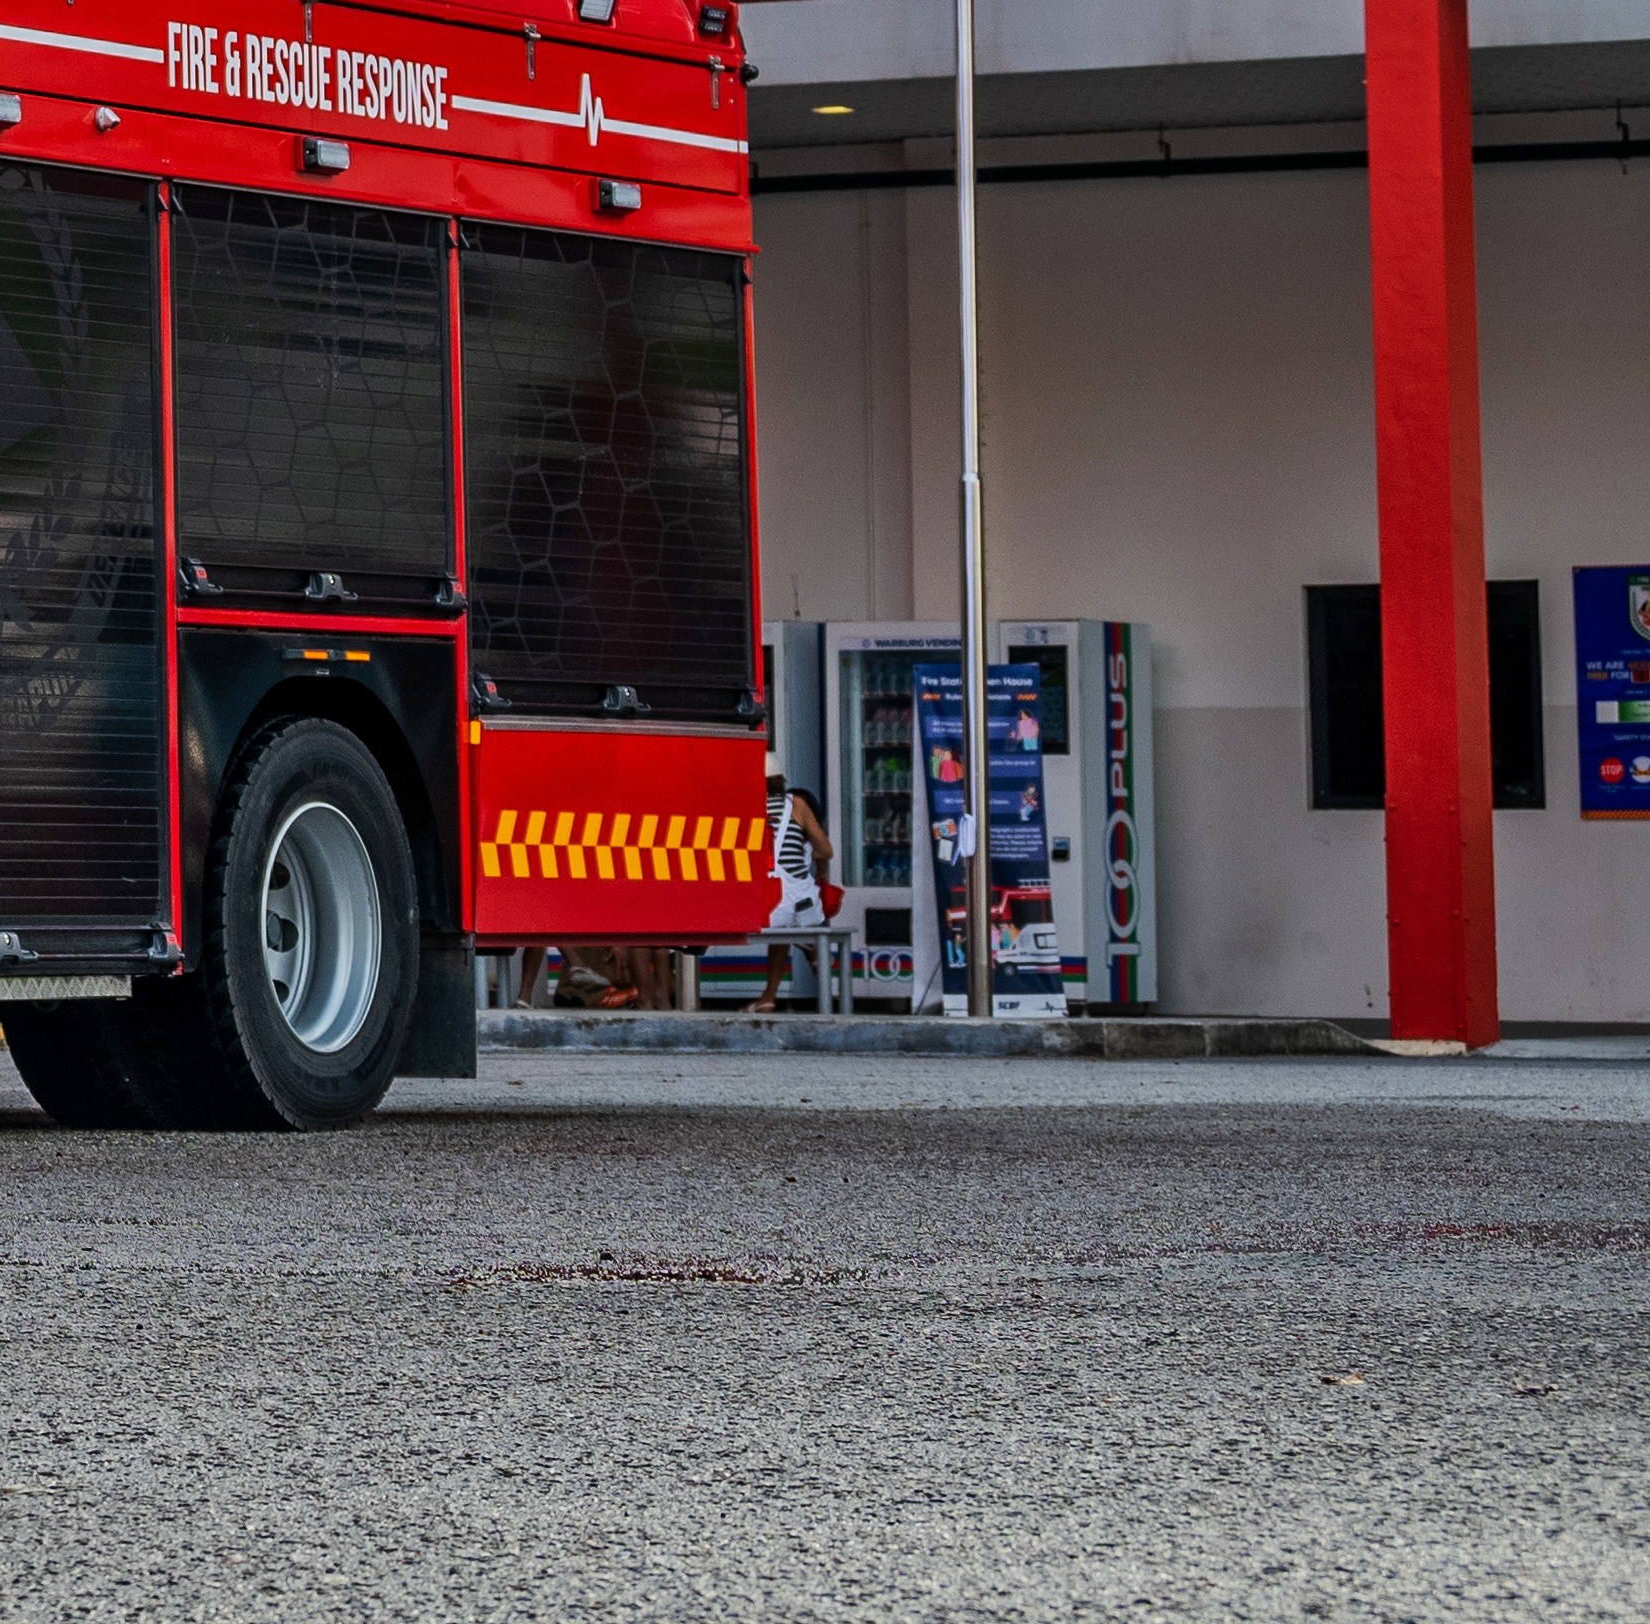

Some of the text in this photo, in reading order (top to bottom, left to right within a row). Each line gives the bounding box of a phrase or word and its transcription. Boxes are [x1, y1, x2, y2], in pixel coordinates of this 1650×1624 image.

[167, 21, 449, 131] FIRE & RESCUE RESPONSE
[924, 639, 963, 648] VENDIN
[1586, 661, 1602, 670] WE
[1605, 660, 1625, 670] ARE
[1610, 671, 1630, 680] FOR
[1003, 676, 1034, 687] House
[1600, 764, 1623, 775] STOP
